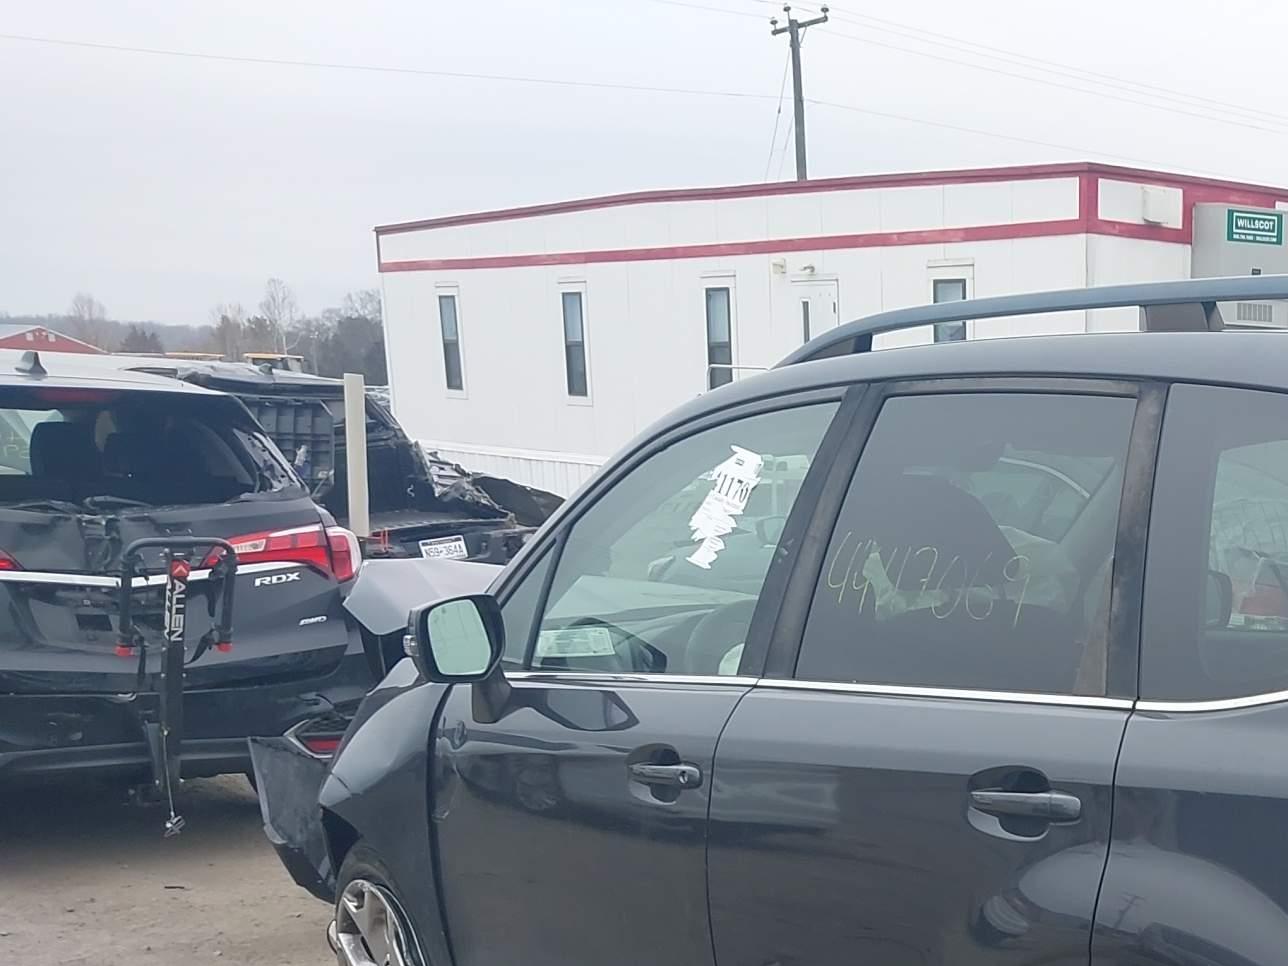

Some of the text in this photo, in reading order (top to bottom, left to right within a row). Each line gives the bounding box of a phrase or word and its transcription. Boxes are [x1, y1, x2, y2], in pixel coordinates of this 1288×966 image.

[1237, 217, 1275, 231] WILLSCOT
[254, 571, 301, 587] RDX
[169, 578, 187, 642] ALLEN
